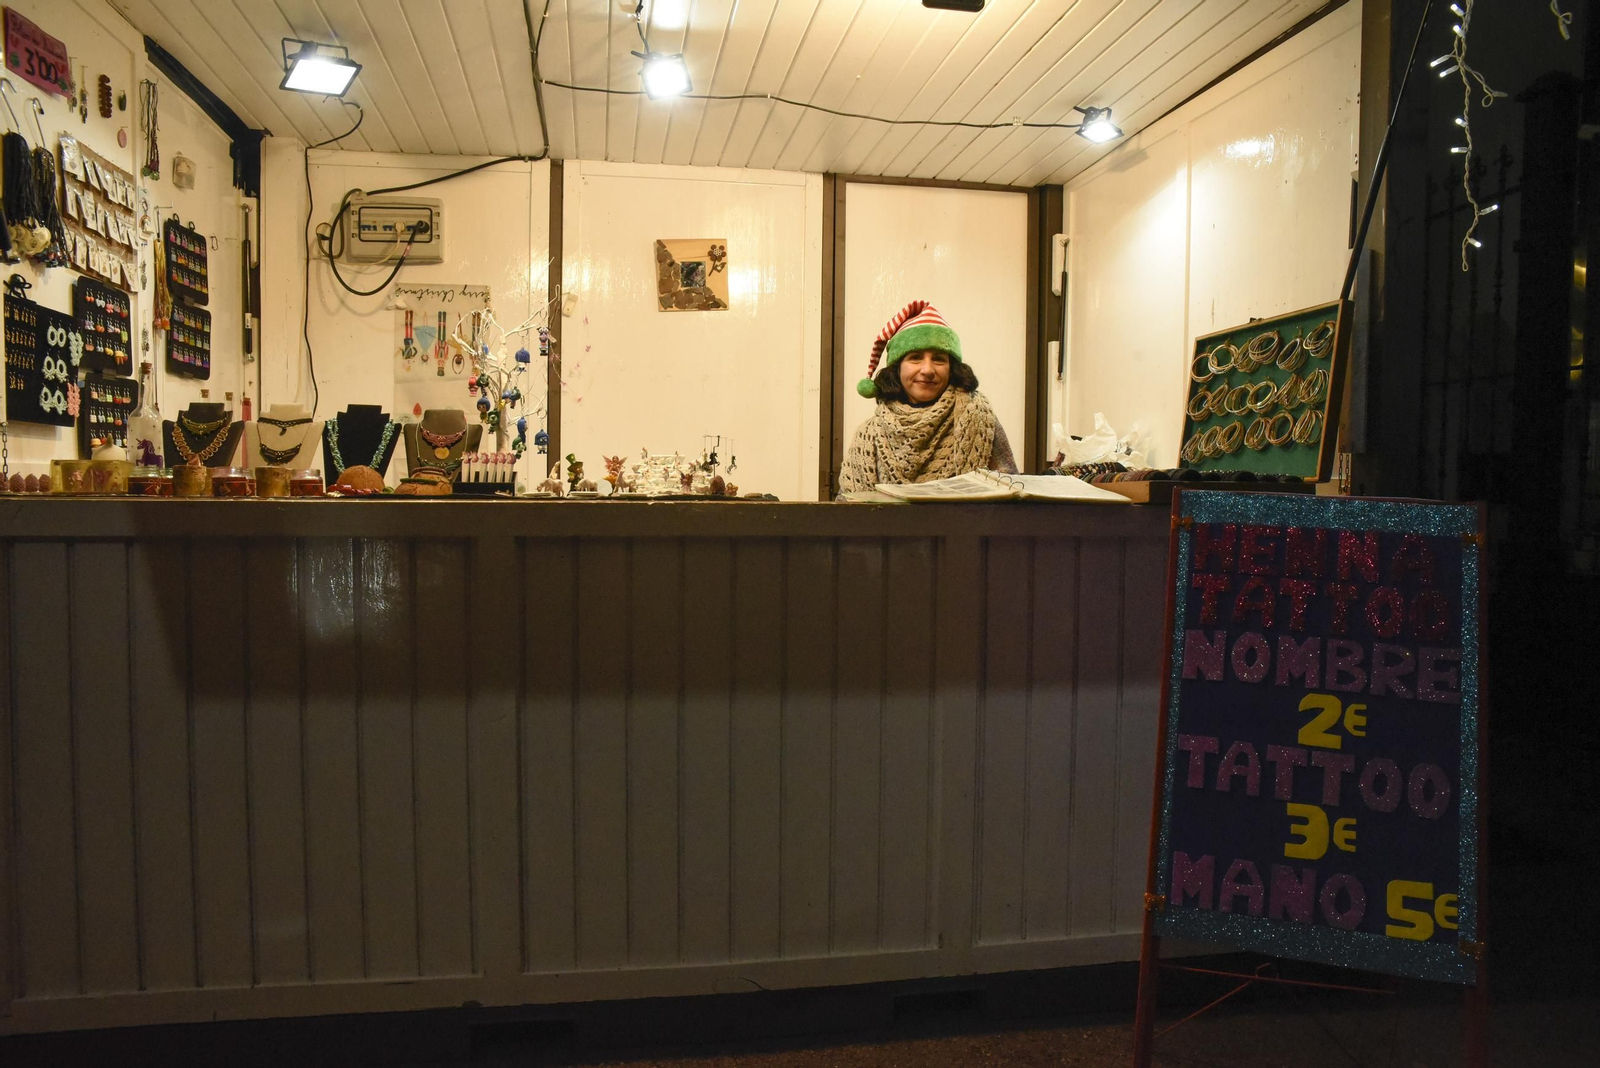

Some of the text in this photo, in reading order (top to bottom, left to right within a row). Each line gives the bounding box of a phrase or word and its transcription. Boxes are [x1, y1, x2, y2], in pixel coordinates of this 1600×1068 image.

[1193, 524, 1436, 587] HENNA
[1193, 574, 1450, 641] TATTOO
[1182, 630, 1461, 704] NOMBRE
[1178, 734, 1451, 819] TATTOO
[1171, 850, 1366, 930] MANO
